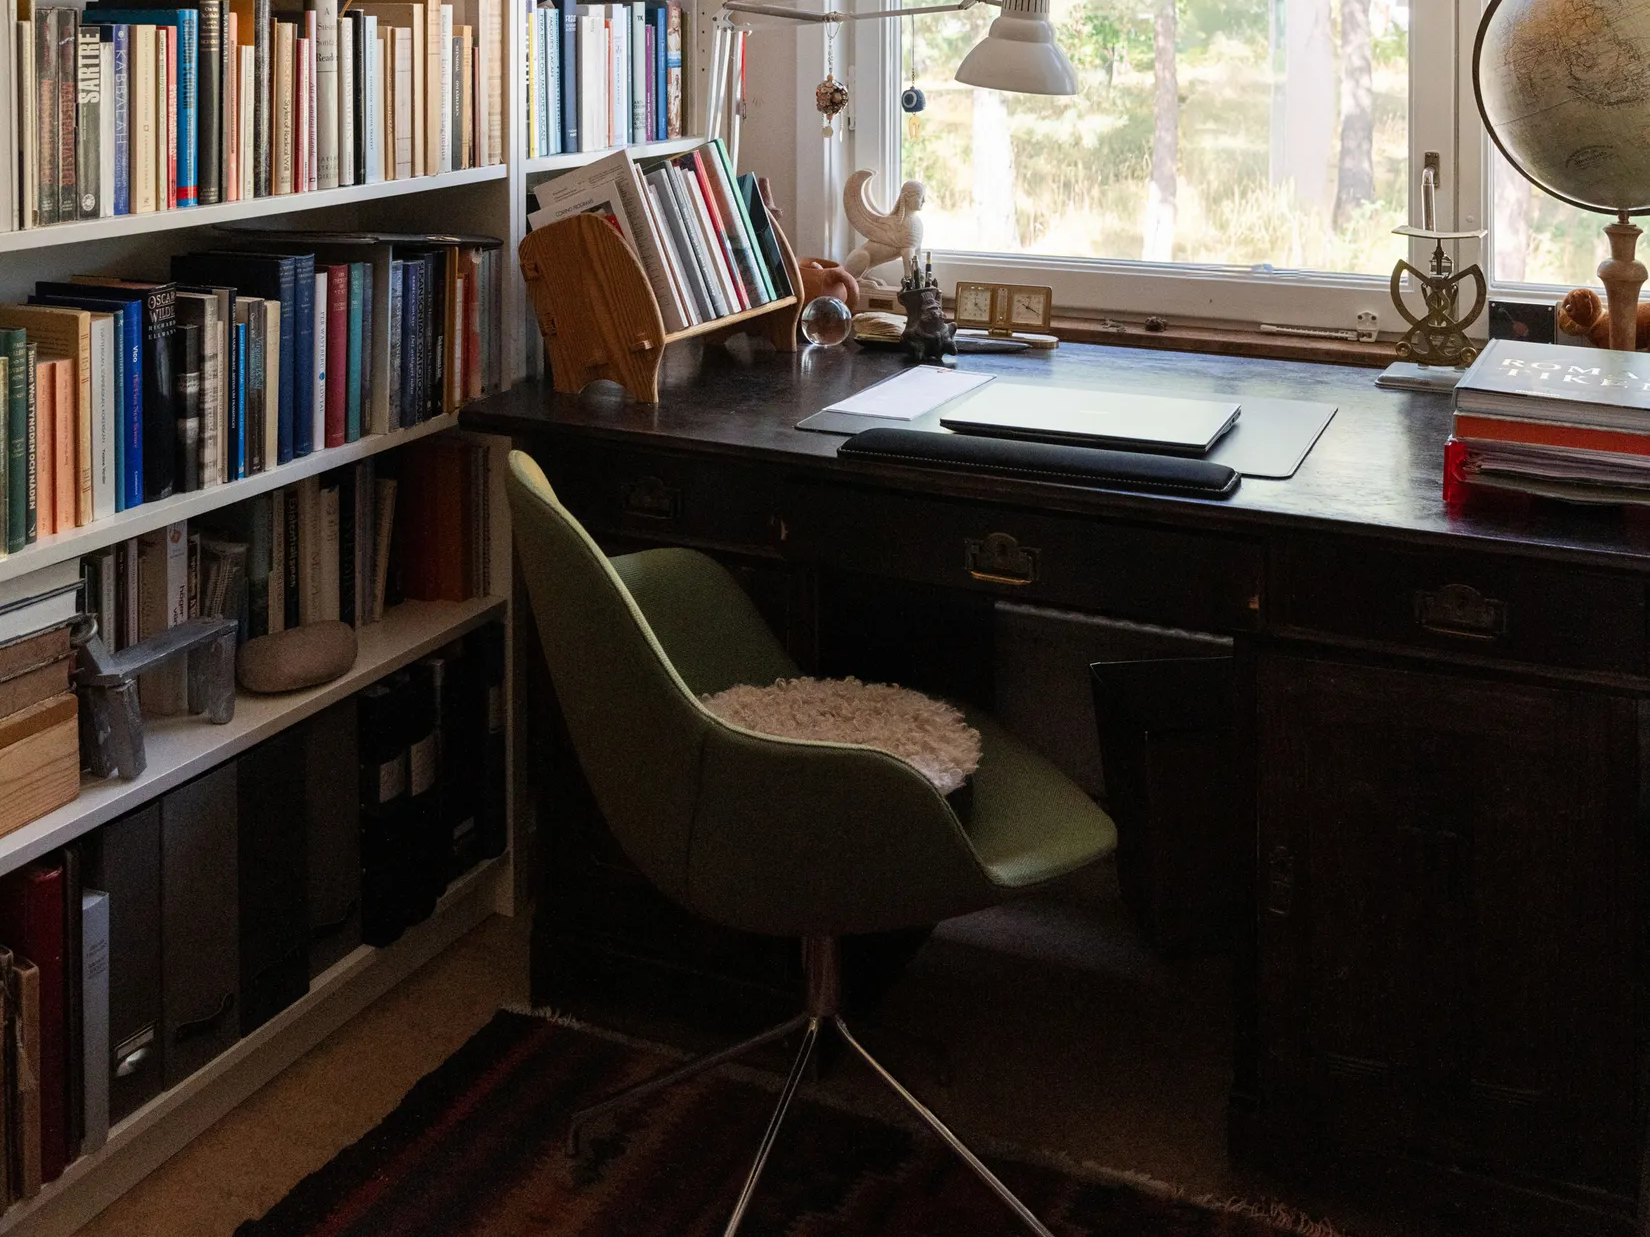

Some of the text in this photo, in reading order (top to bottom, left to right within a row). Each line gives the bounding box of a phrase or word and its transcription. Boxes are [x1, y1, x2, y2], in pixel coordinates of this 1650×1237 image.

[78, 33, 100, 104] SARTRE
[115, 49, 127, 144] KABBALAH
[183, 66, 194, 110] SCHOLEM
[147, 291, 176, 310] OSCAR
[149, 305, 176, 323] WILDE
[417, 342, 424, 360] OM
[28, 476, 36, 510] NÅDEN
[288, 498, 298, 589] Existentialismen
[177, 585, 186, 617] höger
